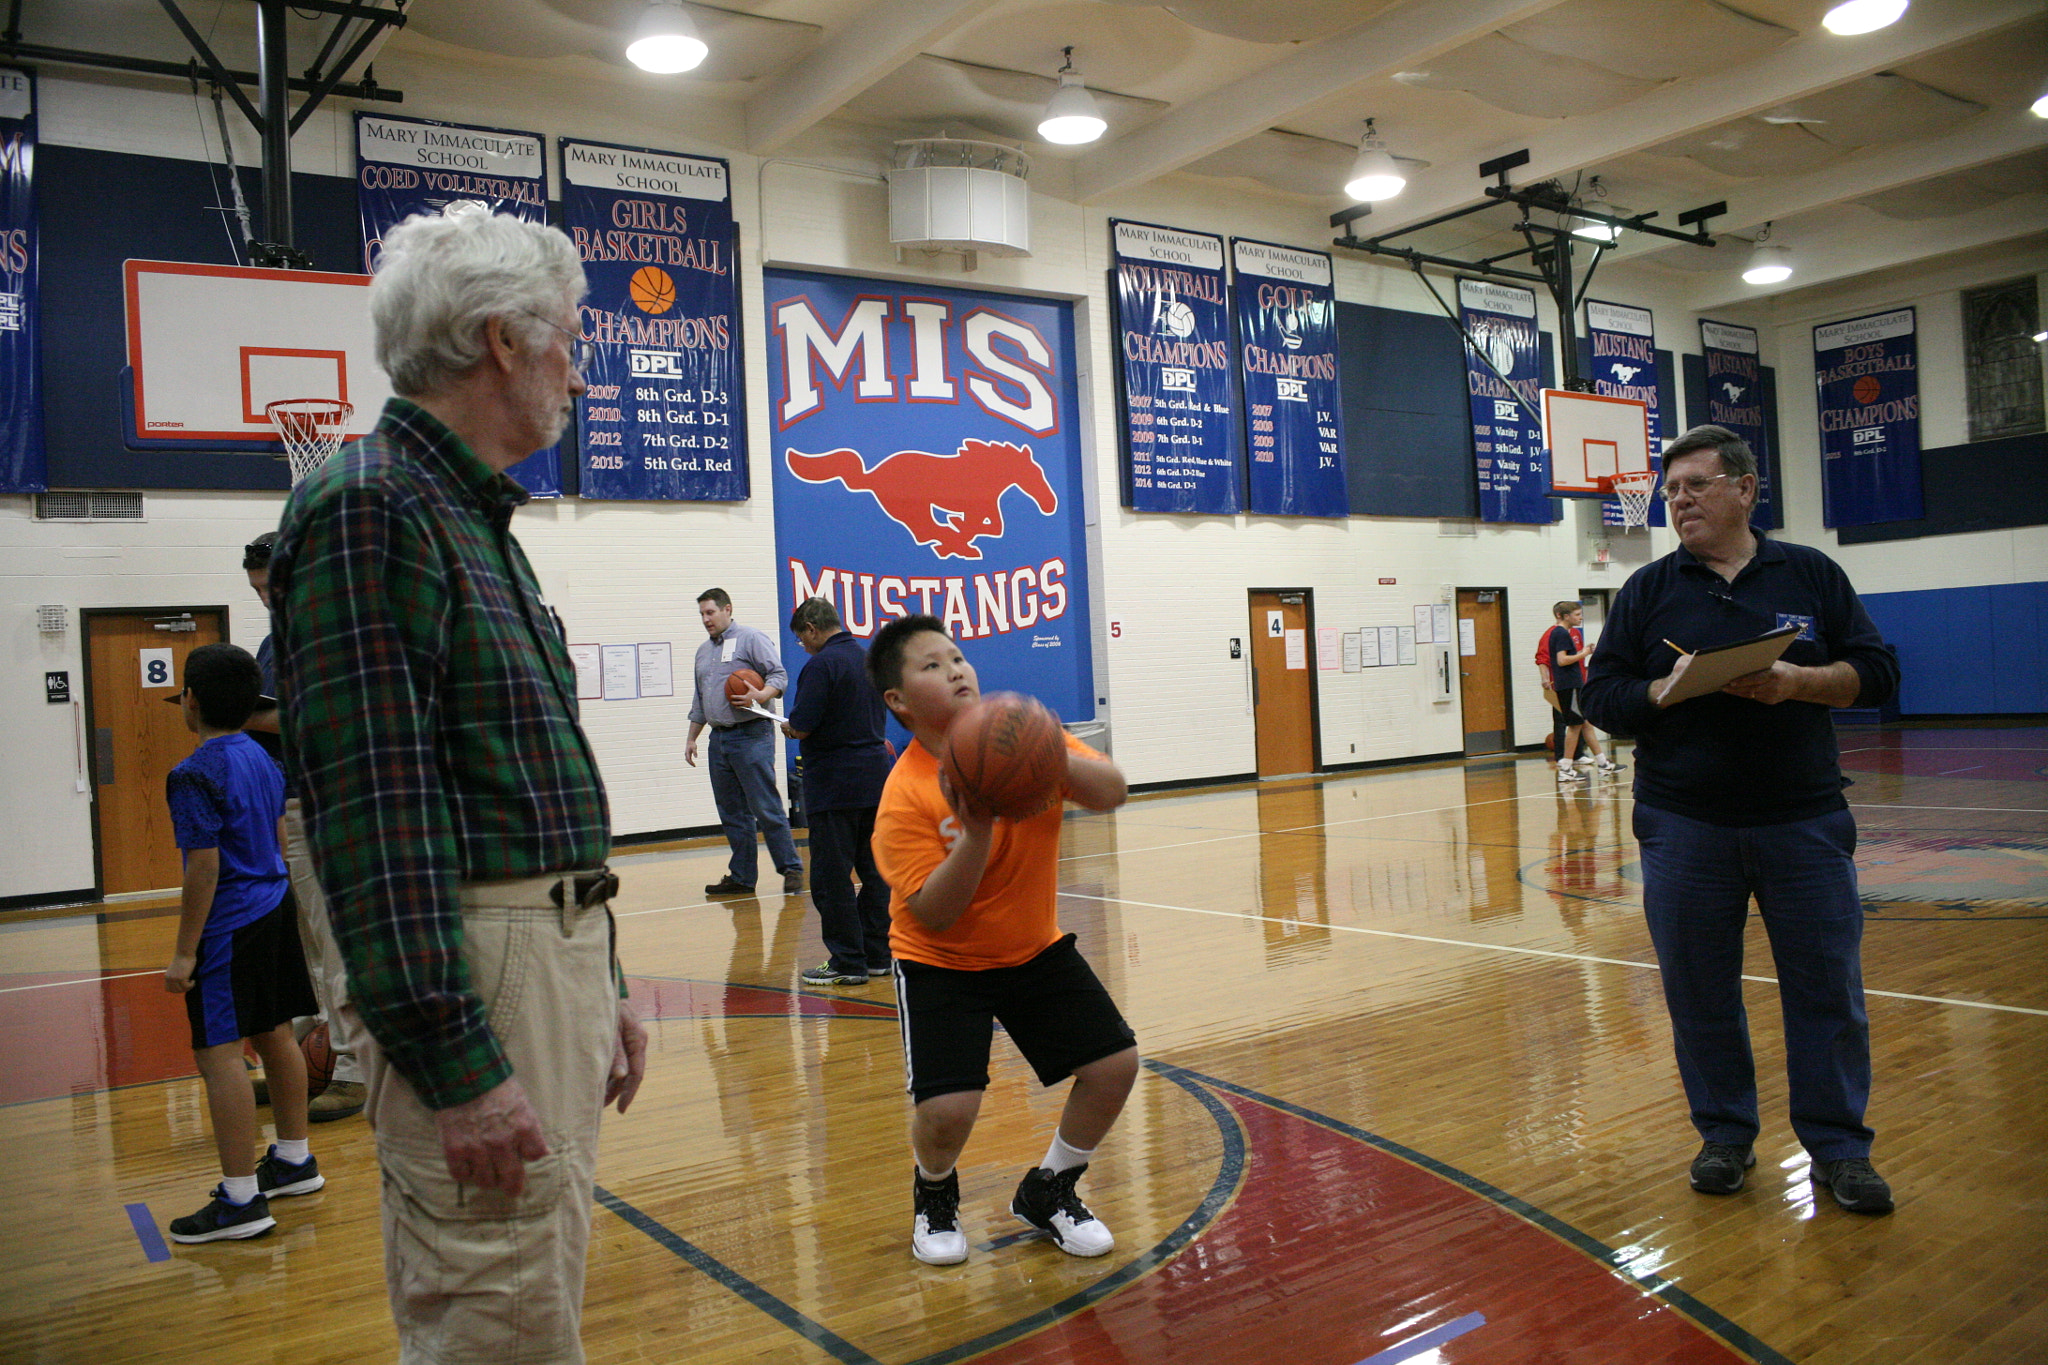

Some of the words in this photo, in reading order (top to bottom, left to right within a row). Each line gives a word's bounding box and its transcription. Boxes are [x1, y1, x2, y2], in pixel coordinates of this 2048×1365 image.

[367, 123, 418, 143] MARY
[424, 129, 535, 156] IMMACULATE
[417, 148, 489, 170] SCHOOL
[571, 148, 617, 168] MARY
[623, 154, 721, 179] IMMACULATE
[361, 165, 420, 189] COED
[422, 171, 545, 207] VOLLEYBALL
[616, 172, 682, 193] SCHOOL
[612, 199, 687, 235] GIRLS
[1119, 227, 1150, 241] MARY
[1153, 231, 1219, 252] IMMACULATE
[571, 226, 727, 276] BASKETBALL
[1149, 247, 1193, 263] SCHOOL
[1239, 246, 1265, 258] MARY
[1269, 249, 1327, 269] IMMACULATE
[1266, 264, 1304, 280] SCHOOL
[1120, 263, 1224, 305] VOLLEYBALL
[1485, 286, 1532, 303] IMMACULATE
[1258, 283, 1314, 315] GOLF
[1483, 300, 1514, 312] SCHOOL
[577, 305, 730, 350] CHAMPIONS
[1819, 327, 1844, 338] MARY
[1847, 314, 1909, 334] IMMACULATE
[1592, 332, 1653, 364] MUSTANG
[1845, 331, 1883, 344] SCHOOL
[1125, 330, 1227, 371] CHAMPIONS
[1844, 342, 1885, 363] BOYS
[631, 354, 682, 375] DPL
[772, 293, 1060, 439] MIS
[1245, 343, 1335, 381] CHAMPIONS
[1707, 351, 1759, 382] MUSTANG
[1820, 354, 1915, 384] BASKETBALL
[1162, 371, 1196, 388] DPL
[1277, 382, 1308, 398] DPL
[587, 384, 621, 400] 2007
[636, 387, 659, 401] 8th
[664, 388, 696, 403] Grd.
[701, 390, 728, 405] D-3
[1130, 395, 1152, 407] 2007
[1154, 399, 1167, 408] 5th
[1168, 400, 1187, 409] Grd.
[1189, 402, 1202, 411] Red
[1203, 402, 1211, 412] &
[1213, 404, 1230, 414] Blue
[1595, 379, 1657, 409] CHAMPIONS
[588, 407, 621, 422] 2010
[637, 409, 661, 423] 8th
[666, 410, 698, 425] Grd.
[703, 412, 729, 426] D-1
[1131, 413, 1154, 425] 2009
[1156, 417, 1169, 426] 6th
[1170, 417, 1189, 427] Grd.
[1190, 418, 1203, 428] D-2
[1252, 404, 1273, 416] 2007
[1317, 411, 1332, 423] J.V.
[1495, 403, 1519, 417] DPL
[1710, 400, 1761, 426] CHAMPIONS
[1821, 395, 1918, 432] CHAMPIONS
[589, 432, 622, 446] 2012
[642, 433, 666, 447] 7th
[669, 434, 700, 449] Grd.
[703, 436, 729, 449] D-2
[1132, 431, 1155, 443] 2009
[1157, 434, 1169, 443] 7th
[1171, 434, 1190, 444] Grd.
[1192, 435, 1203, 446] D-1
[1318, 427, 1337, 438] VAR
[1854, 430, 1885, 442] DPL
[1254, 435, 1274, 447] 2009
[1319, 442, 1338, 453] VAR
[591, 456, 624, 470] 2015
[644, 457, 668, 470] 5th
[670, 458, 701, 471] Grd.
[705, 459, 732, 472] Red
[1133, 452, 1151, 461] 2011
[1166, 456, 1180, 464] Grd.
[1319, 457, 1335, 468] J.V.
[1134, 464, 1152, 475] 2012
[788, 556, 1068, 641] MUSTANGS
[1111, 621, 1122, 638] 5
[1272, 618, 1281, 635] 4
[147, 659, 168, 684] 8
